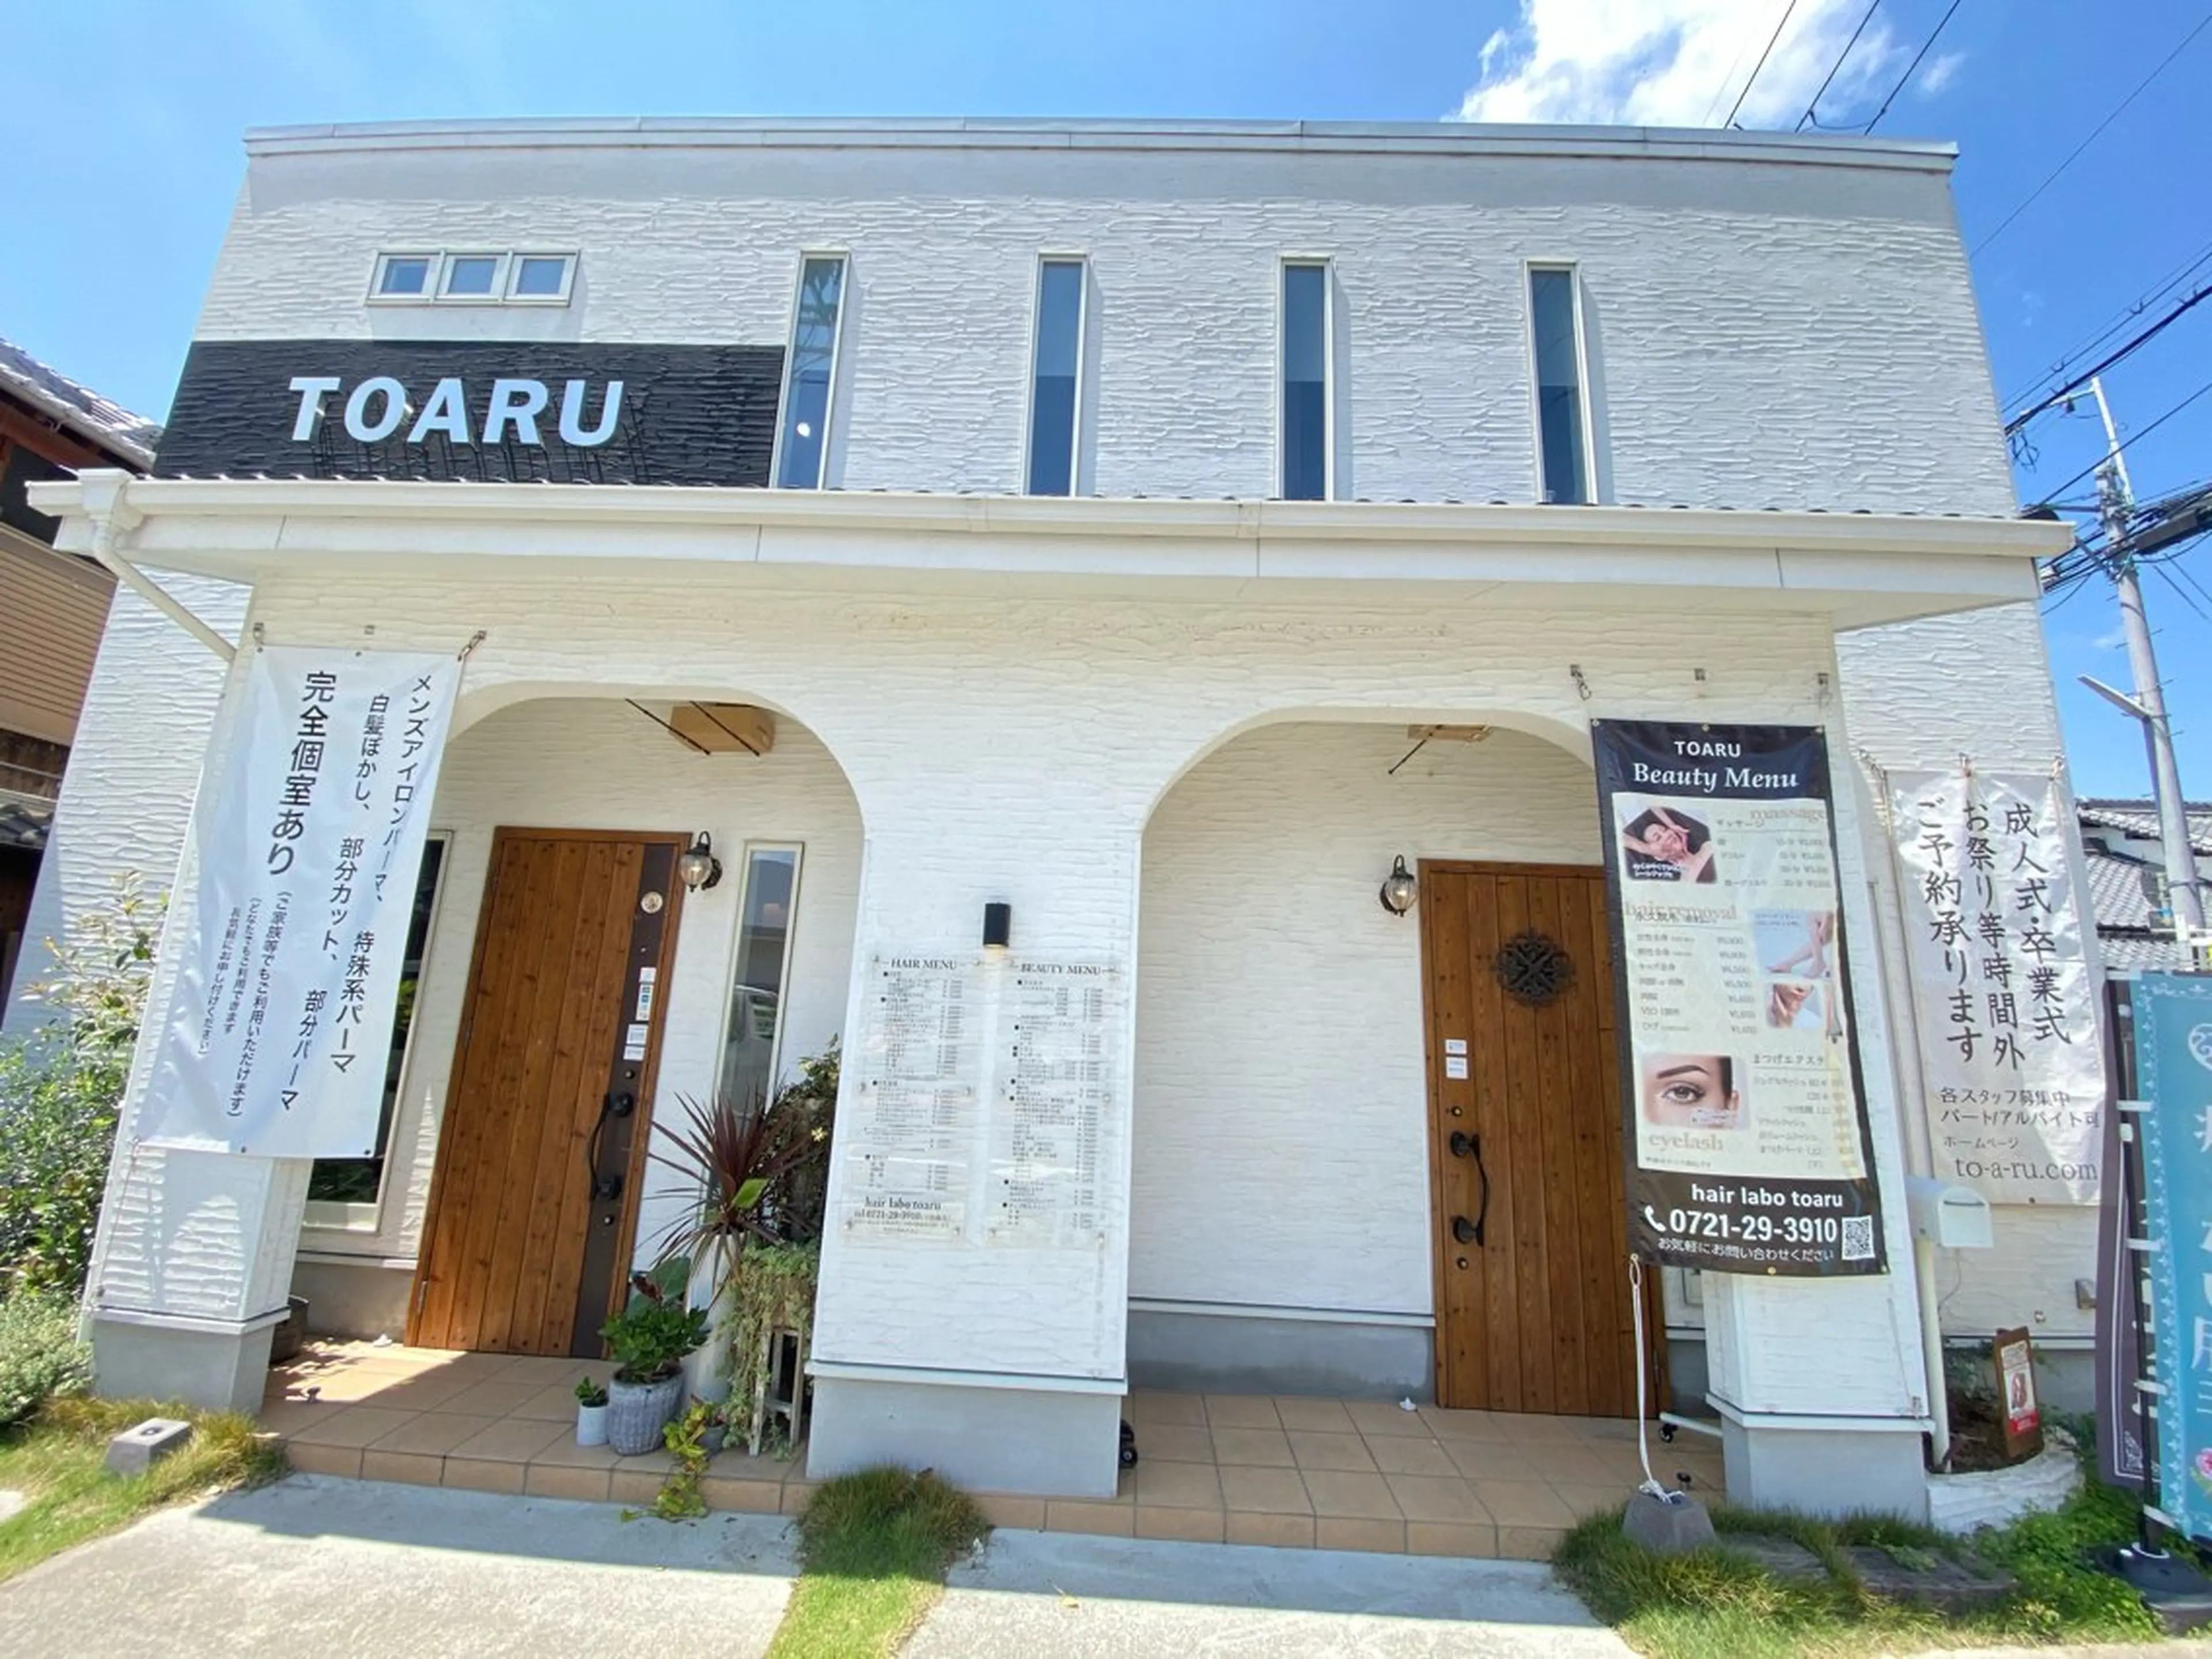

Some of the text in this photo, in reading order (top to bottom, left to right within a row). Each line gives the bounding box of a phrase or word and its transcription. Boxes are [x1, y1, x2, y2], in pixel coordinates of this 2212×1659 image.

[288, 376, 623, 446] TOARU
[1675, 740, 1741, 757] TOARU
[266, 671, 336, 875] 完全個室あり
[1633, 762, 1799, 793] Beauty Menu
[281, 694, 389, 1110] 白髪ぼかし、 部分カット、 部分パーマ
[1917, 797, 1983, 1063] ご予約承ります
[1964, 802, 2025, 1070] お祭り等時間外
[2005, 802, 2071, 1046] 成人式・卒業式
[891, 958, 957, 970] HAIR MENU
[1021, 963, 1101, 976] BEAUTY MENU
[1940, 1086, 2070, 1107] 各スタッフ募集中
[1649, 1132, 1724, 1152] eyelash
[1944, 1136, 2019, 1149] ホームページ
[1955, 1158, 2098, 1181] to-a-ru.com
[1692, 1183, 1843, 1207] hair labo toaru
[1669, 1209, 1837, 1243] 0721-29-3910
[1657, 1237, 1834, 1262] お気軽にお問い合わせください
